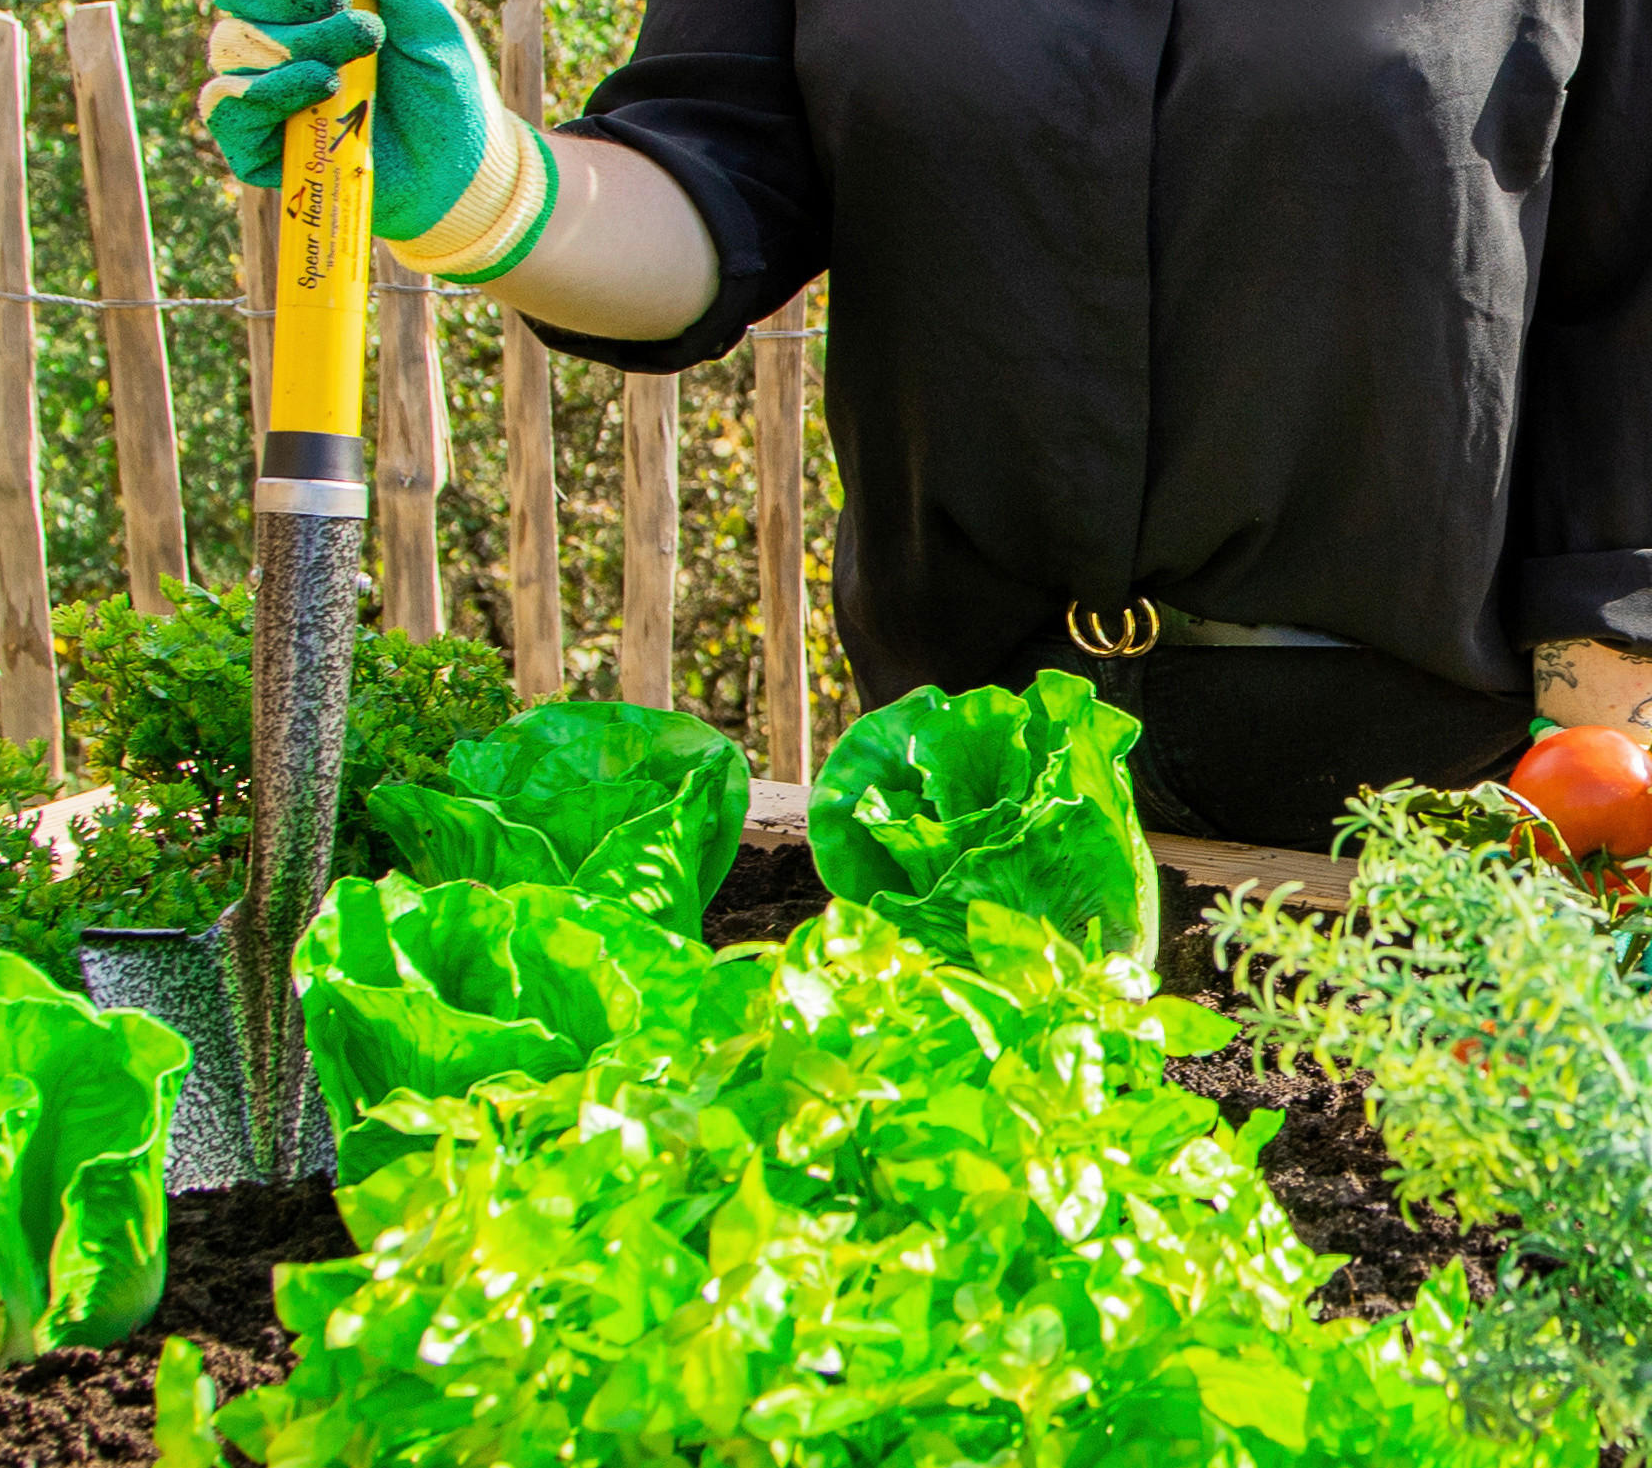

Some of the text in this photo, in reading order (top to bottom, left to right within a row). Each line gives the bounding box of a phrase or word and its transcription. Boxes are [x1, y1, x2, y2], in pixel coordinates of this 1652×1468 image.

[298, 117, 334, 290] Spear Head Spade
